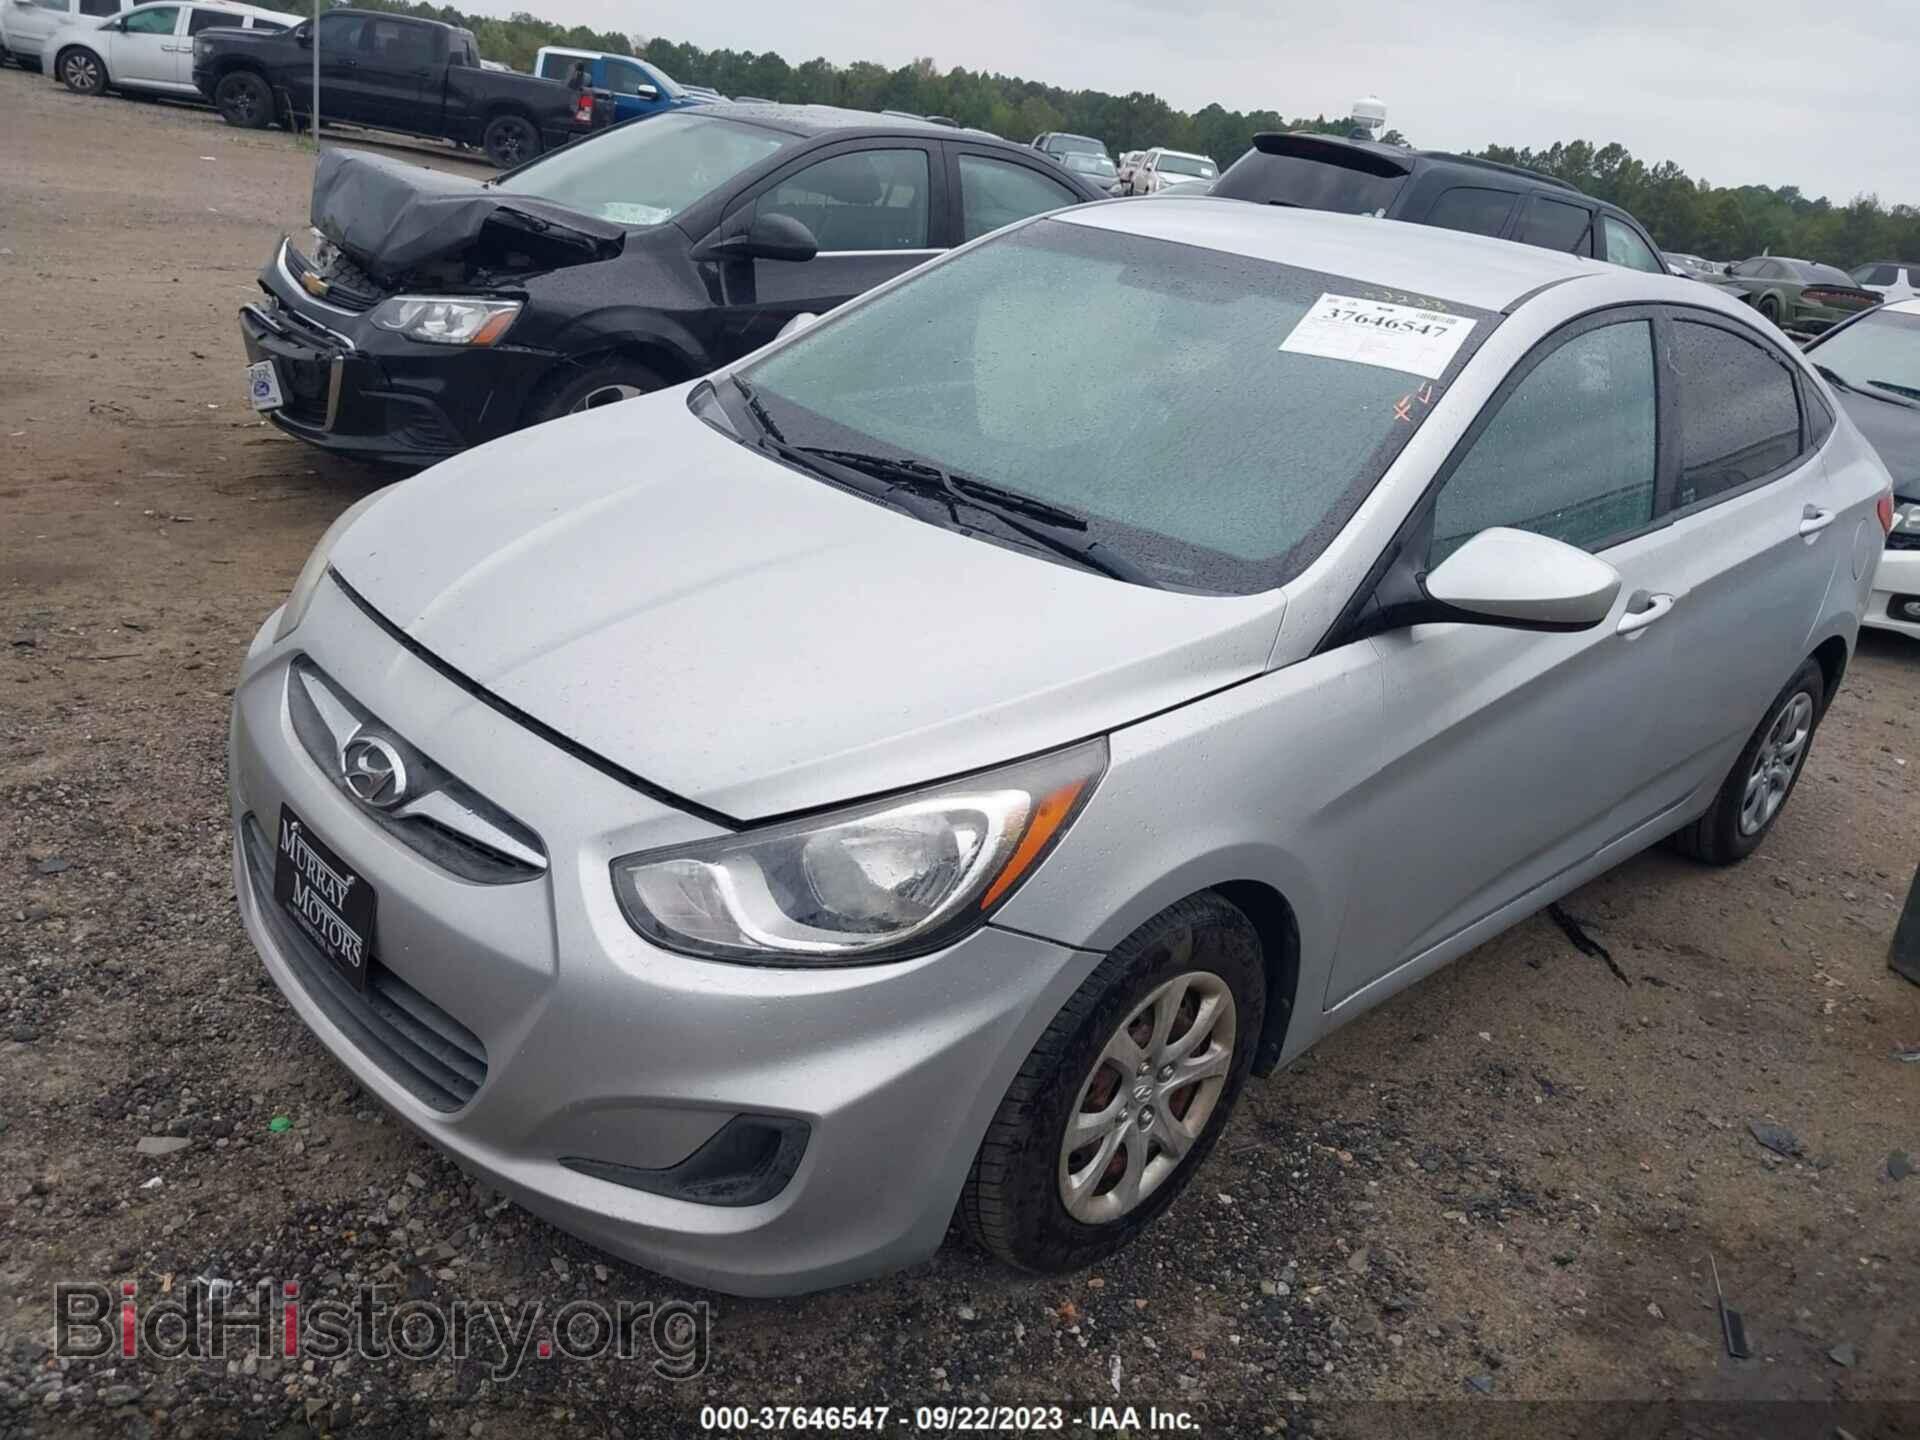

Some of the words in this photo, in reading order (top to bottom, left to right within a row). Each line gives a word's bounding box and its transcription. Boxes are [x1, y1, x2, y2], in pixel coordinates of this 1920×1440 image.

[1322, 307, 1448, 338] 37646547
[280, 818, 349, 911] MURRAY
[292, 872, 363, 967] MOTORS
